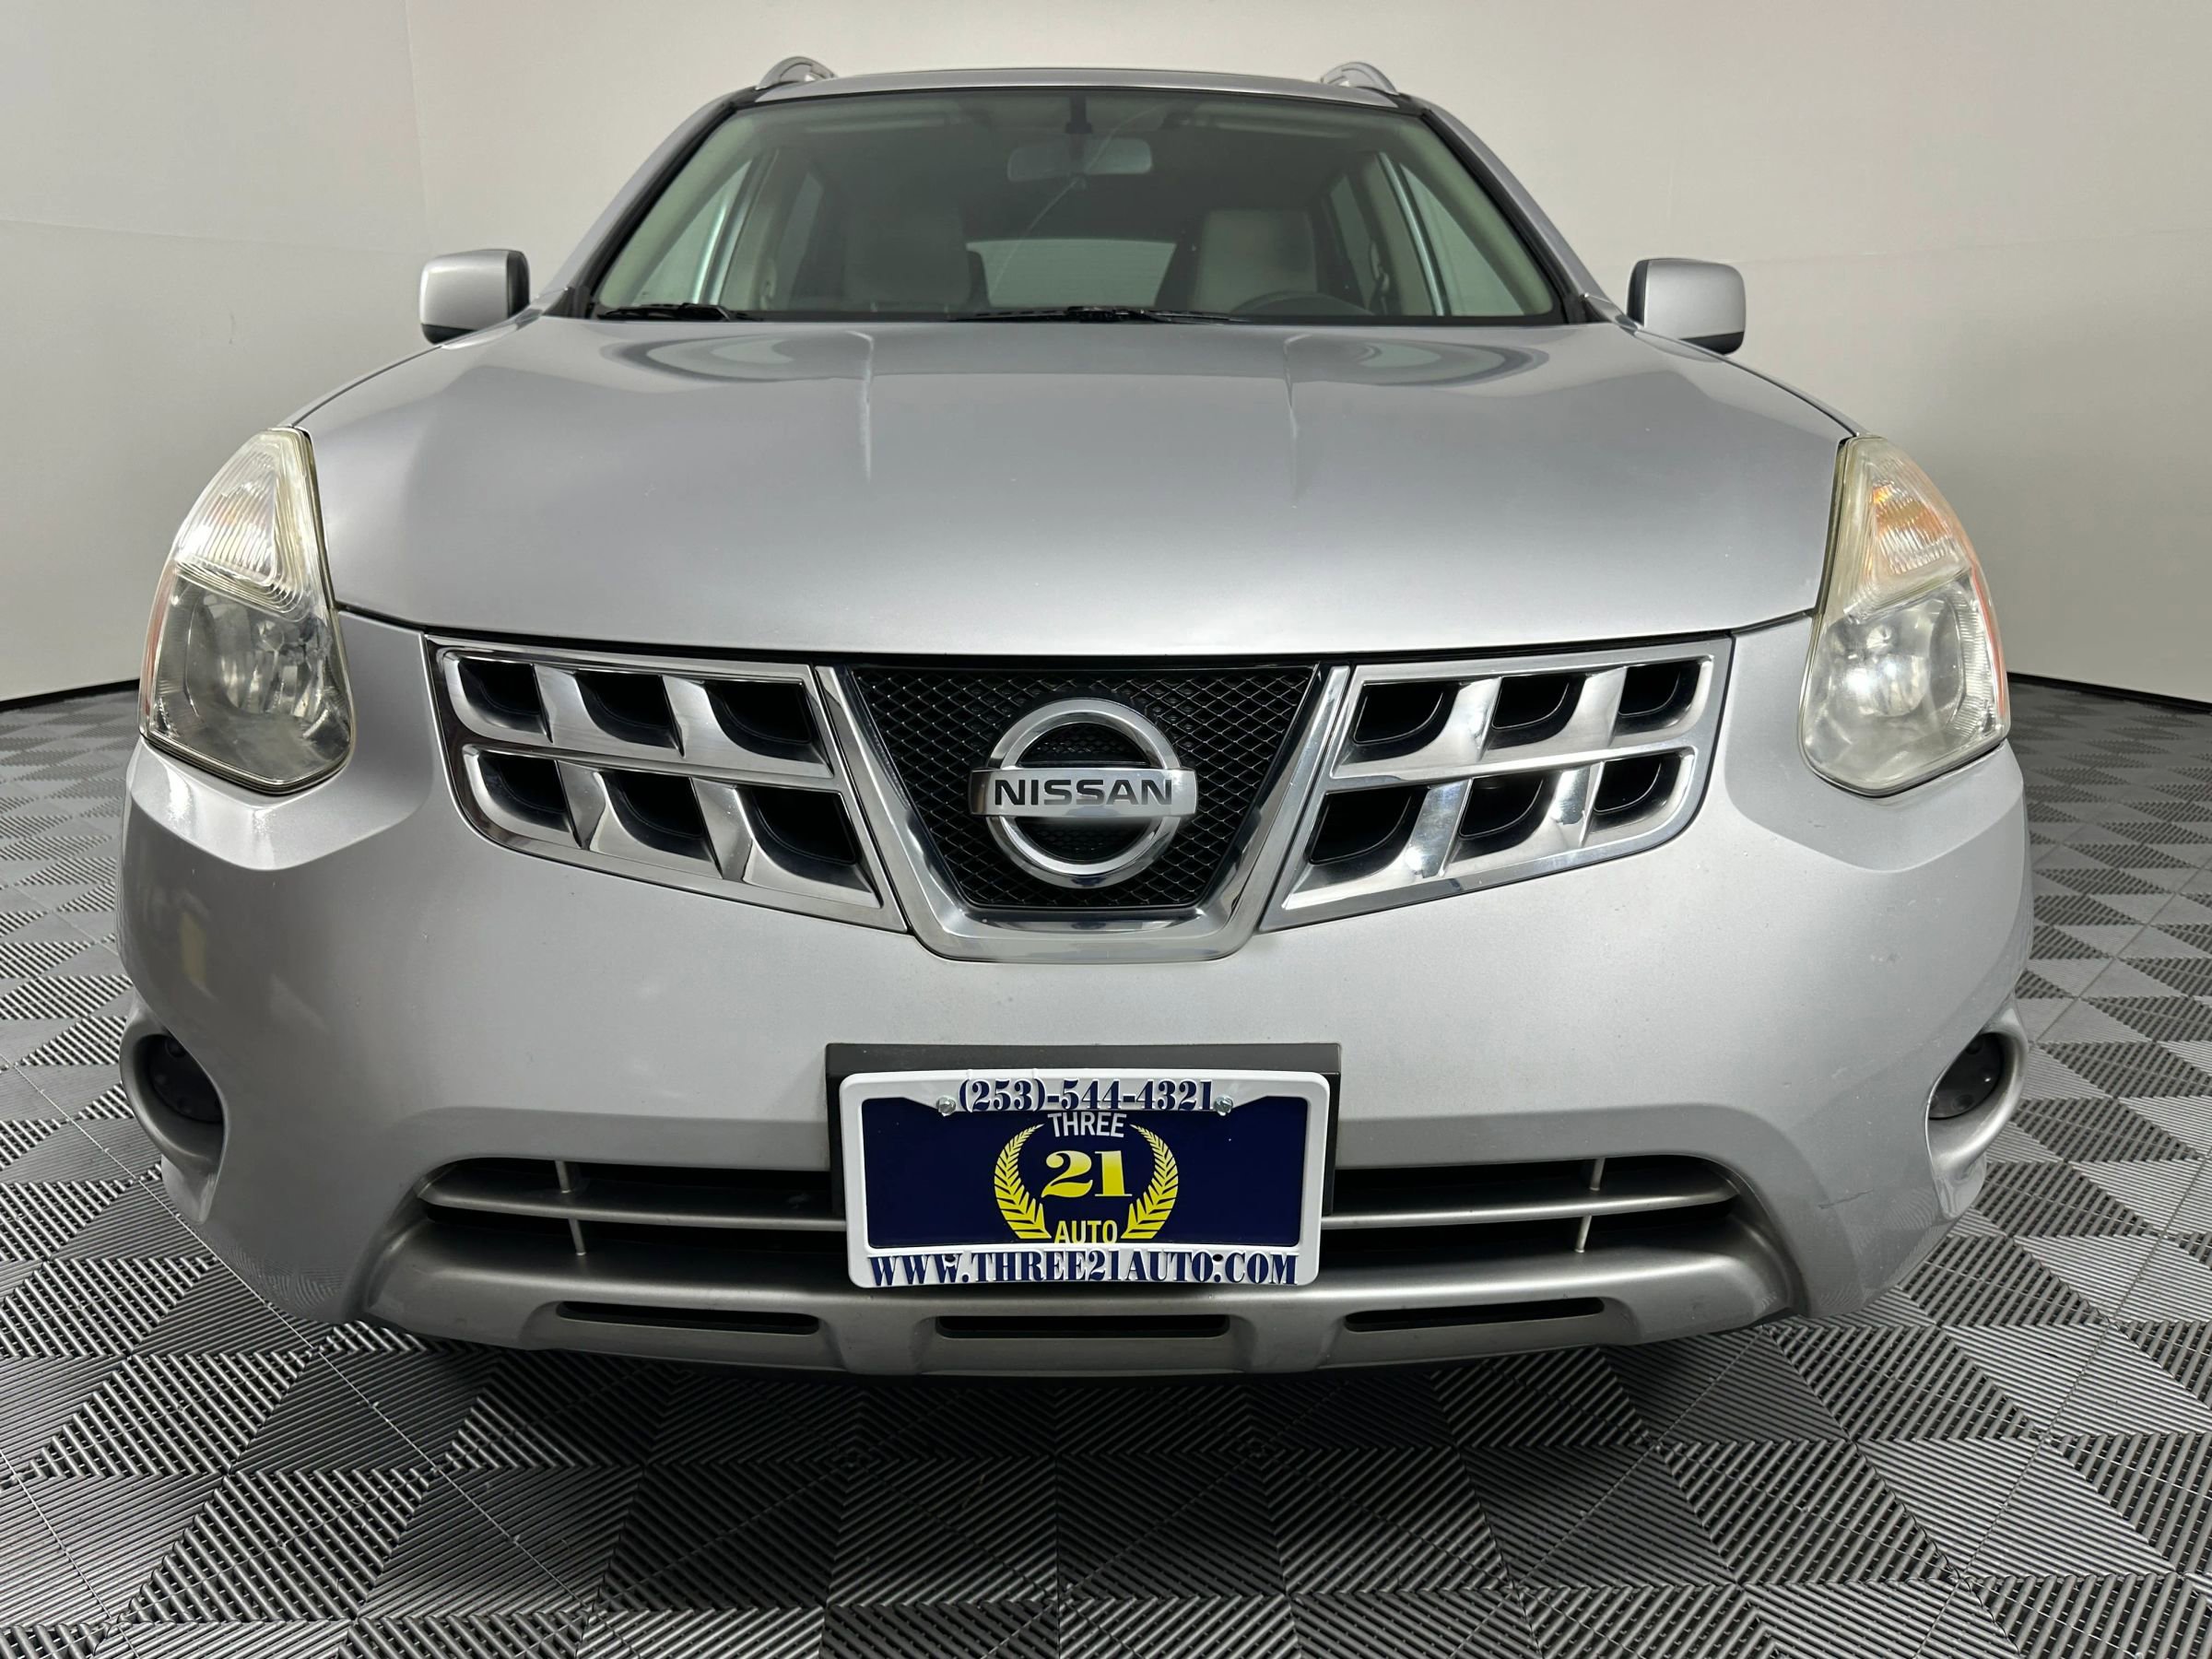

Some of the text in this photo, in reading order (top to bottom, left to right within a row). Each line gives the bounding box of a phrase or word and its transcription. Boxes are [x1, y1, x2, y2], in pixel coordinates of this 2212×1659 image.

[994, 779, 1172, 806] NISSAN
[959, 1077, 1214, 1112] (253)-544-4321
[1048, 1112, 1127, 1138] THREE
[1041, 1150, 1133, 1198] 21
[1054, 1219, 1118, 1244] AUTO
[868, 1248, 1299, 1287] WWW.THREE21AUTO.COM
